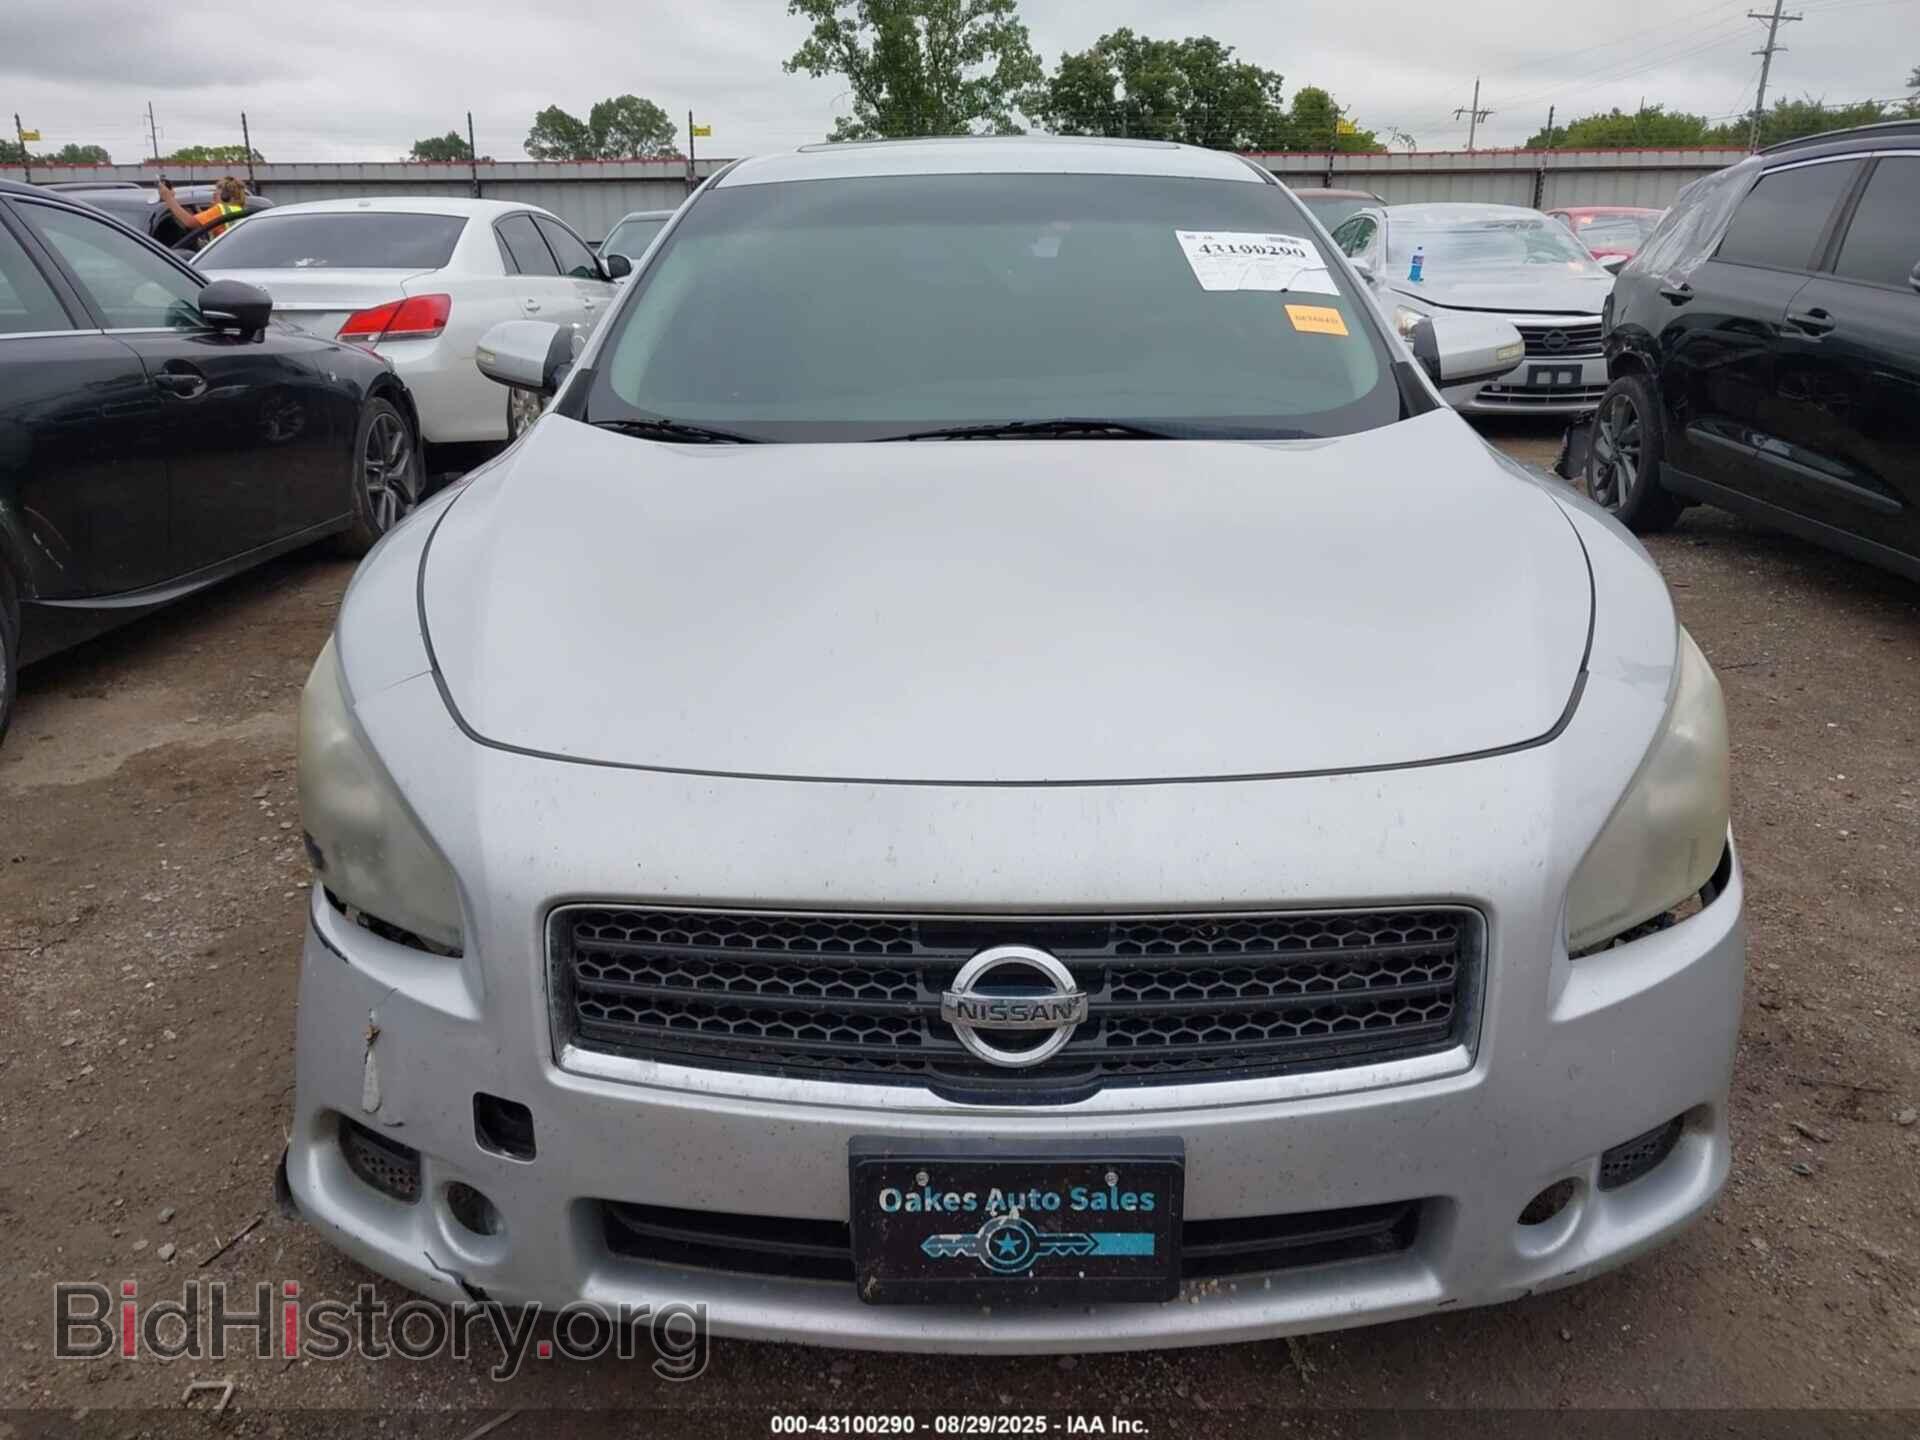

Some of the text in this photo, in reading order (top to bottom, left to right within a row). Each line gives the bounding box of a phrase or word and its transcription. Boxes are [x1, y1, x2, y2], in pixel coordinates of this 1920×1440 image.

[957, 1001, 1073, 1022] NISSAN
[879, 1187, 1155, 1213] Oakes Auto Sales
